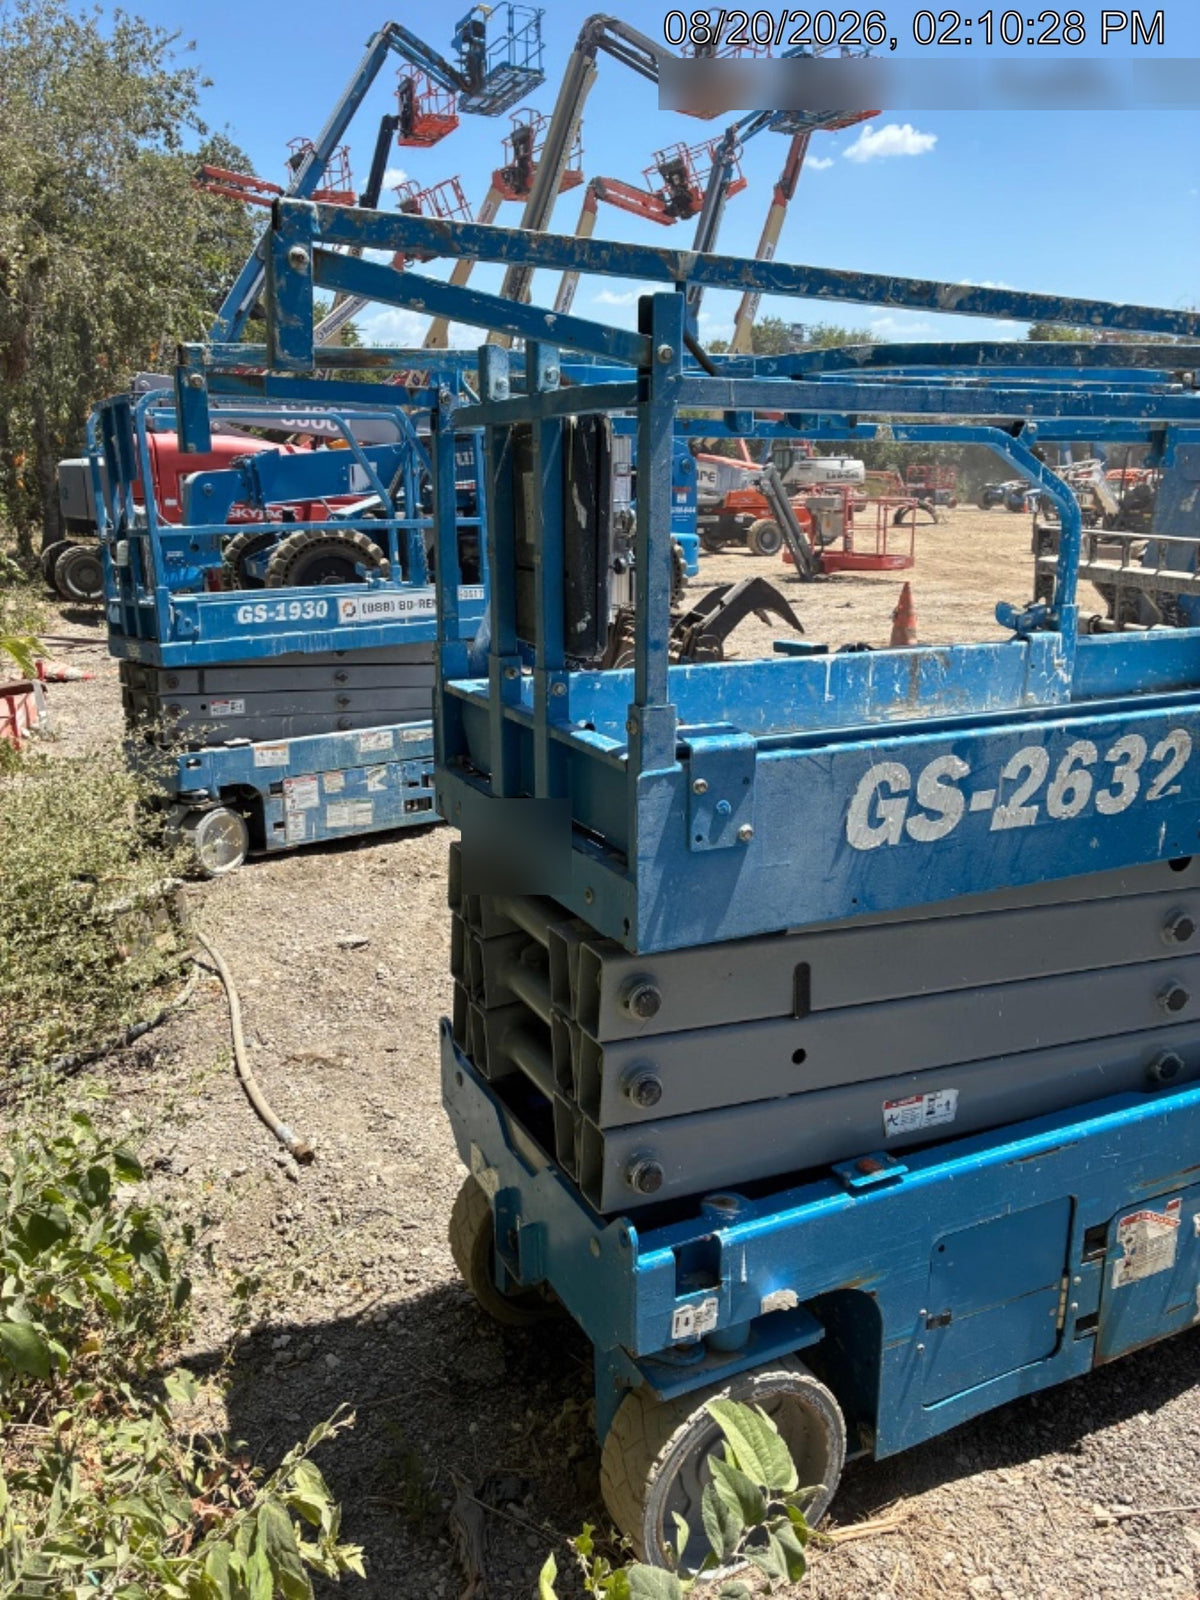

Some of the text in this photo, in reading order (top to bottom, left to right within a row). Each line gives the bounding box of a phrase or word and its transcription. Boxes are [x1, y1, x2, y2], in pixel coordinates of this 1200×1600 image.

[237, 600, 328, 624] GS-1930
[362, 600, 395, 614] (888)
[846, 729, 1192, 850] GS-2632
